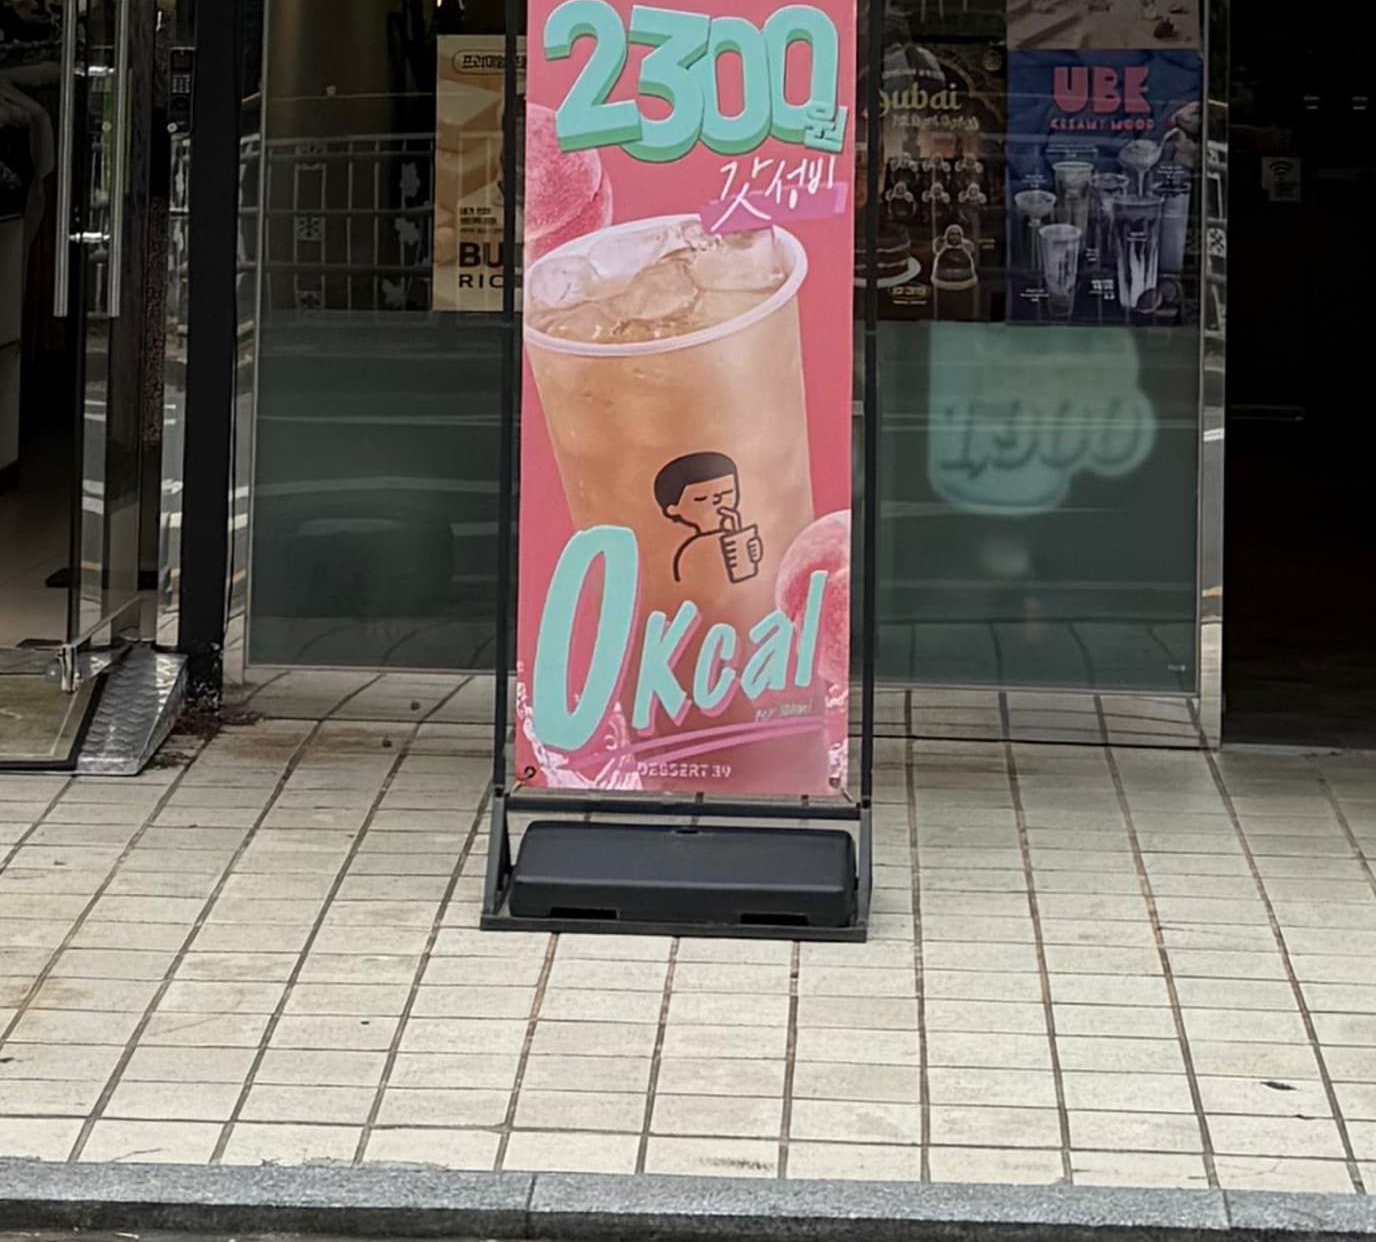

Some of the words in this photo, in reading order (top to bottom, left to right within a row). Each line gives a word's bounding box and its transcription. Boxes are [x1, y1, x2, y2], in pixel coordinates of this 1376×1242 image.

[1052, 66, 1151, 113] UBE
[710, 155, 836, 232] 갓성비
[637, 762, 709, 779] DESSERT
[711, 764, 732, 779] 39
